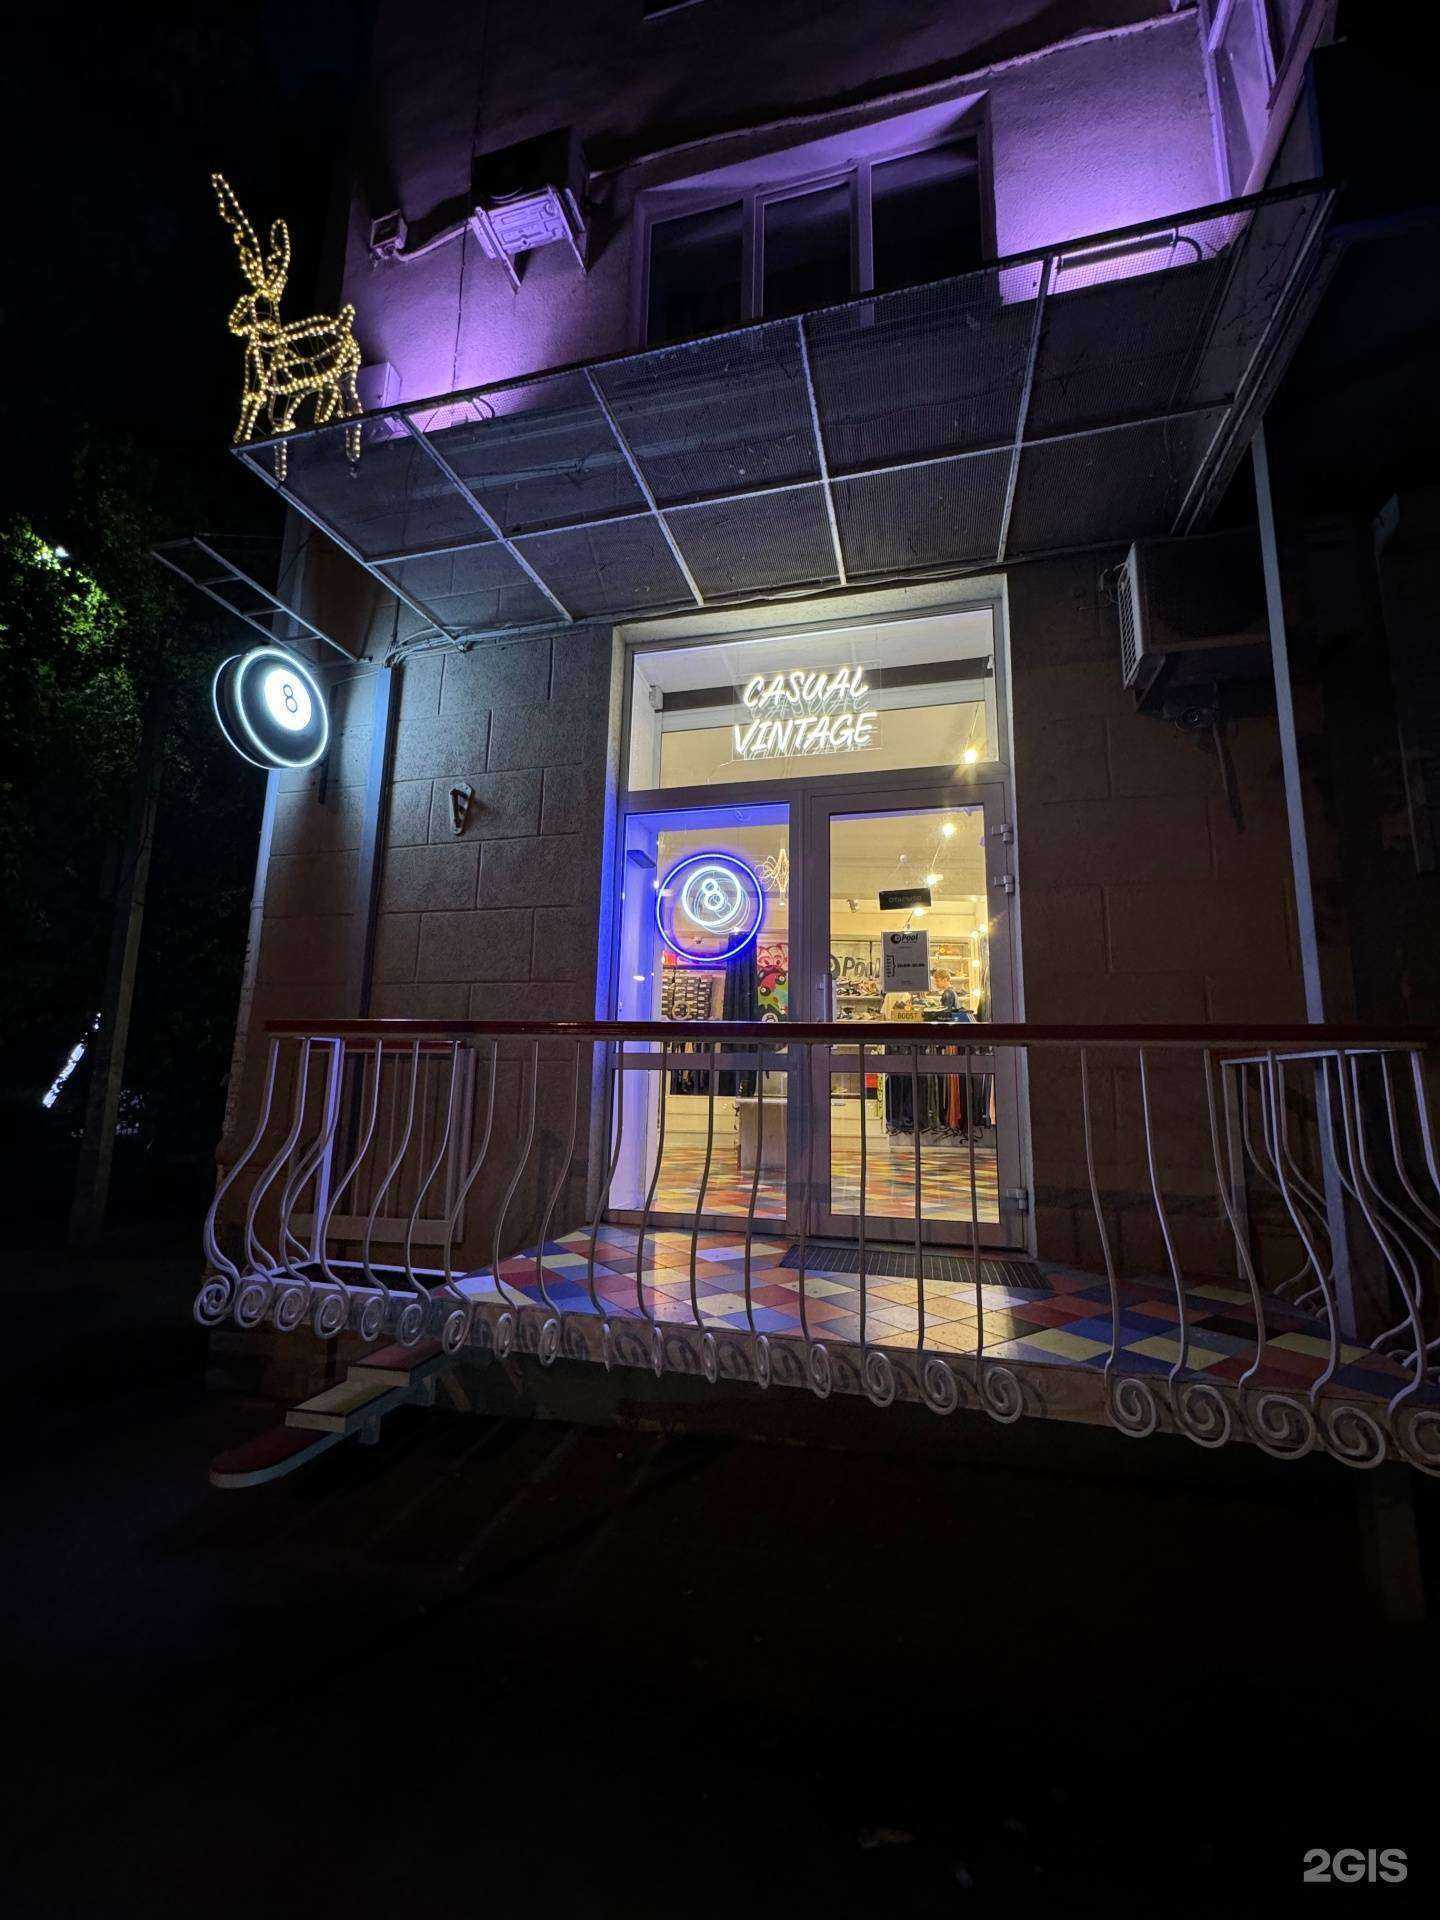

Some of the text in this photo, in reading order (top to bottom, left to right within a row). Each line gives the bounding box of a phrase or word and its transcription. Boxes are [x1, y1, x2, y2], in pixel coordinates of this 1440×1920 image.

[283, 684, 298, 713] 8
[744, 666, 869, 707] CASUAL
[734, 711, 878, 754] VINTAGE
[702, 878, 726, 911] 8
